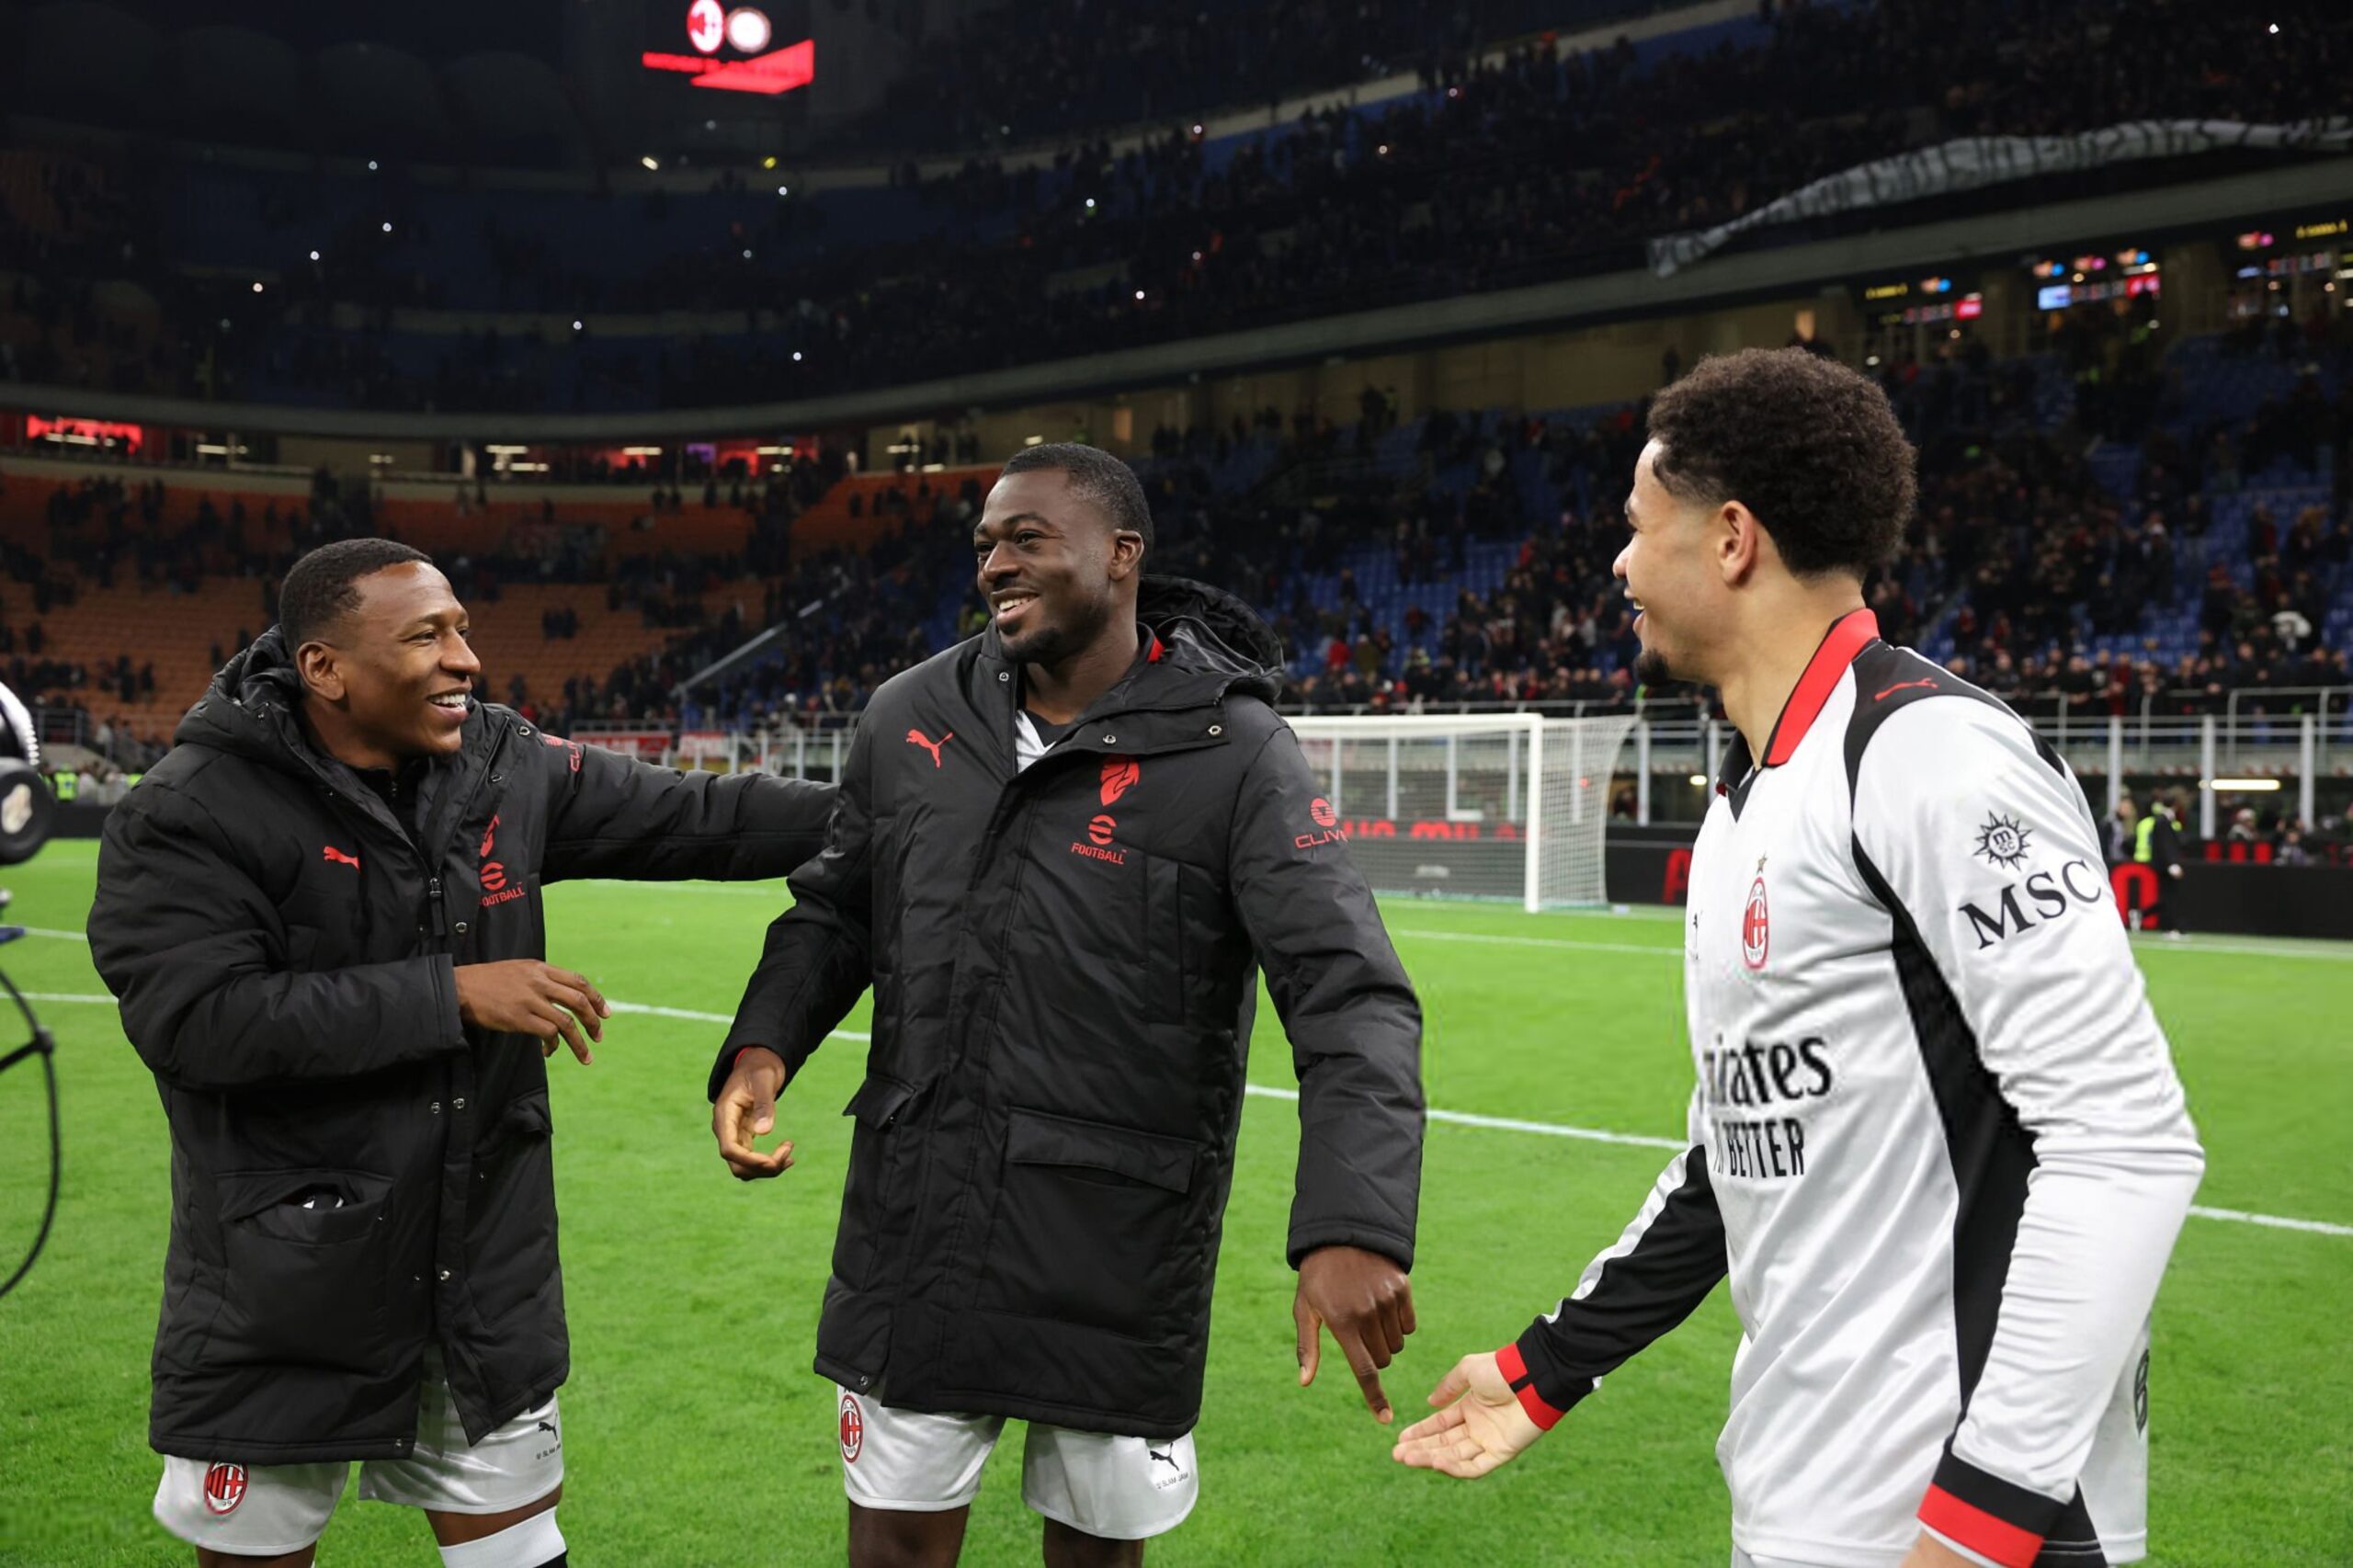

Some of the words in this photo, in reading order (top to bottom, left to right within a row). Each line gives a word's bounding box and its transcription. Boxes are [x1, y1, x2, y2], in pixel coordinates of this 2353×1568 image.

[1071, 842, 1124, 865] FOOTBALL
[481, 886, 525, 907] OOTBALL
[1958, 859, 2102, 950] MSC
[1722, 1118, 1804, 1178] BETTER
